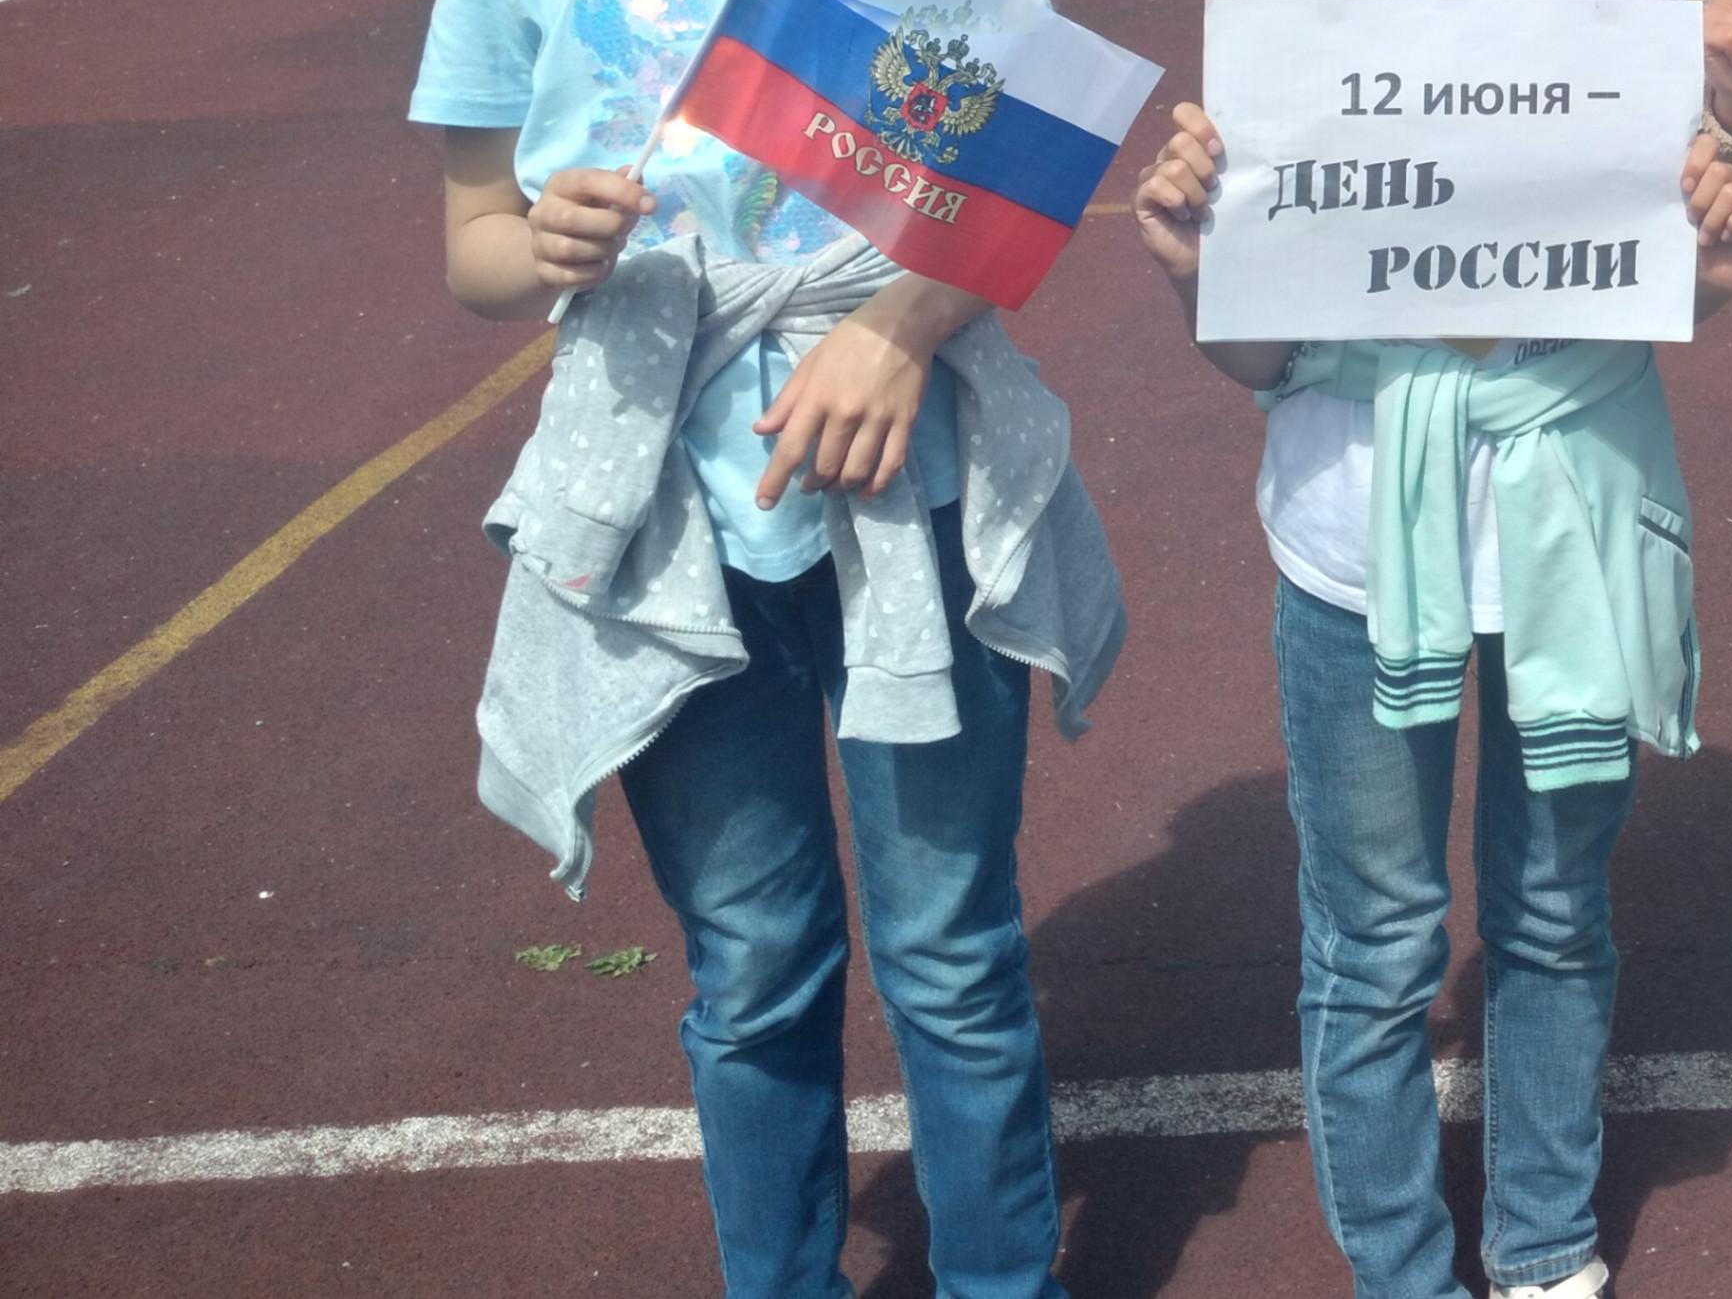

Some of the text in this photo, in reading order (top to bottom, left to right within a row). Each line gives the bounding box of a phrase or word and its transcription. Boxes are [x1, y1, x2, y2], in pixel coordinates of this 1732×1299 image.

[1340, 72, 1403, 116] 12
[1423, 82, 1572, 116] июня
[803, 111, 969, 225] РОССИЯ
[1267, 157, 1456, 221] ДЕНЬ
[1366, 239, 1641, 294] РОССИИ
